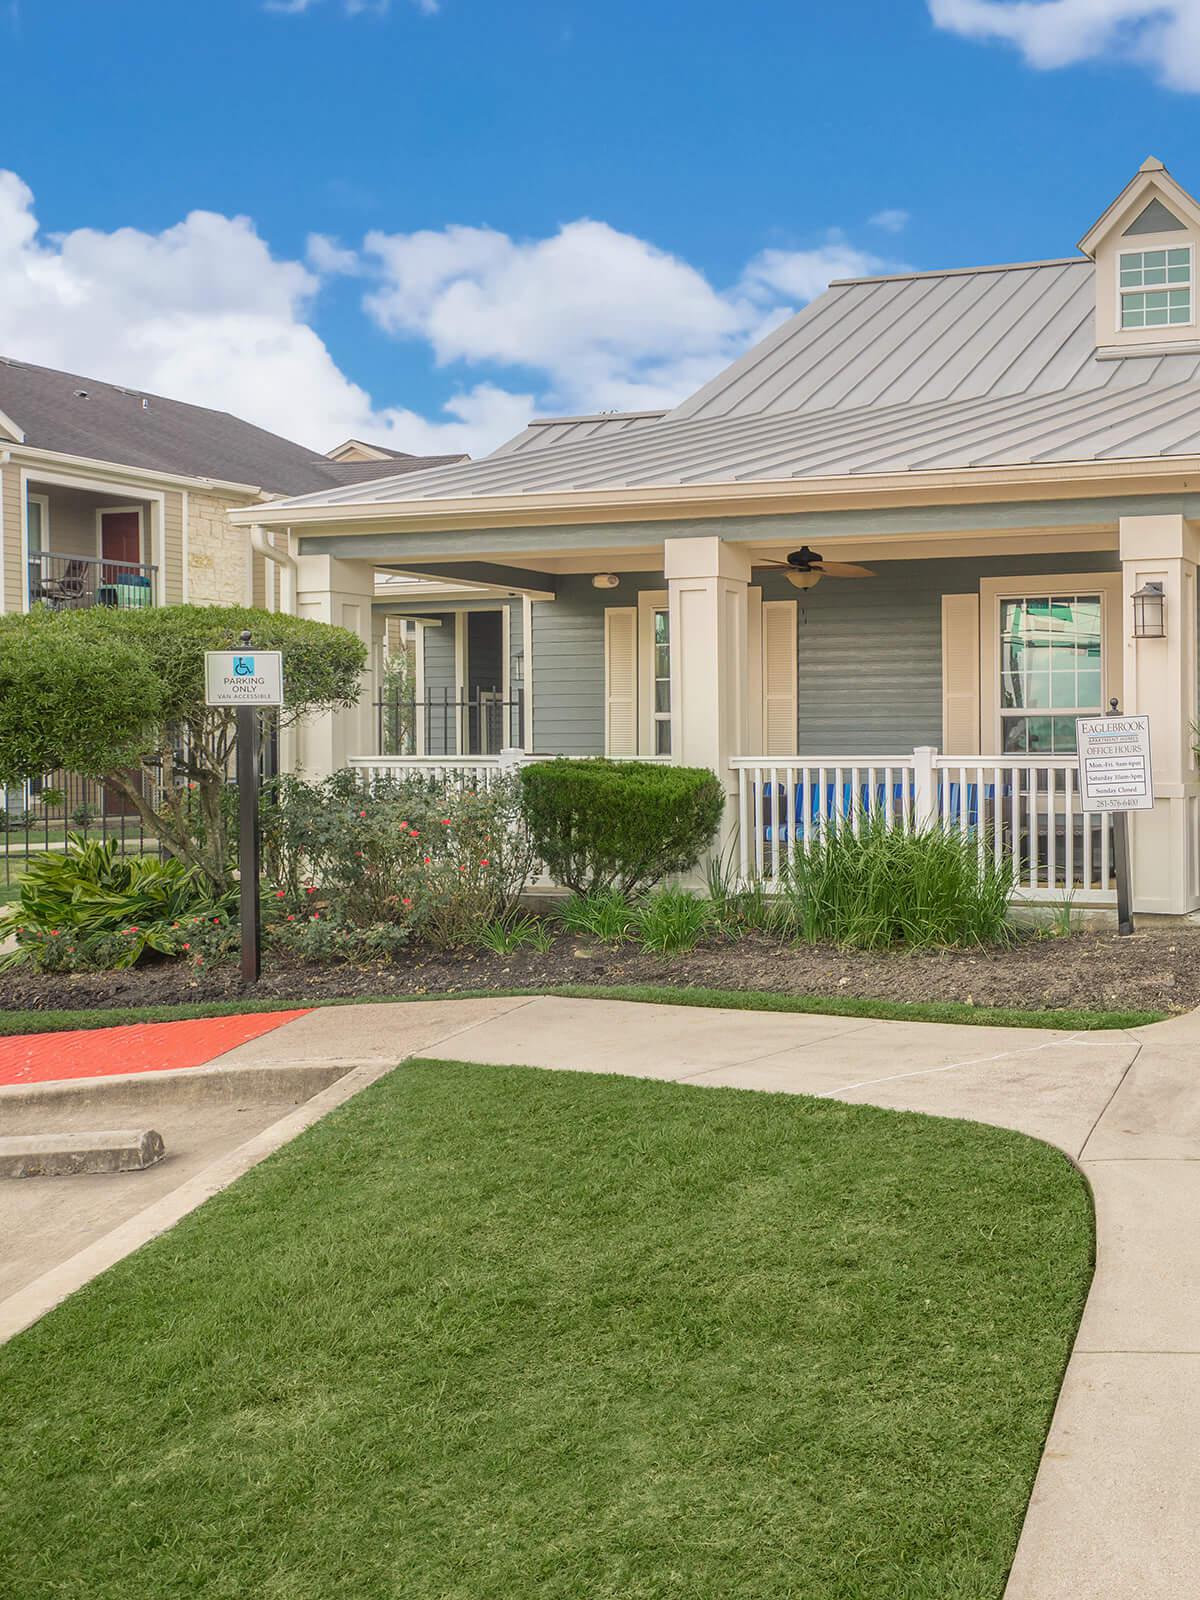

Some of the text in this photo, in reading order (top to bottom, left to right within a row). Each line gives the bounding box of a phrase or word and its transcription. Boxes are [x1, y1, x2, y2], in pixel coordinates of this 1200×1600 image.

[224, 677, 264, 685] PARKING
[232, 685, 257, 693] ONLY
[1082, 721, 1145, 733] EAGLEBROOK
[1087, 744, 1142, 755] OFFICE HOURS
